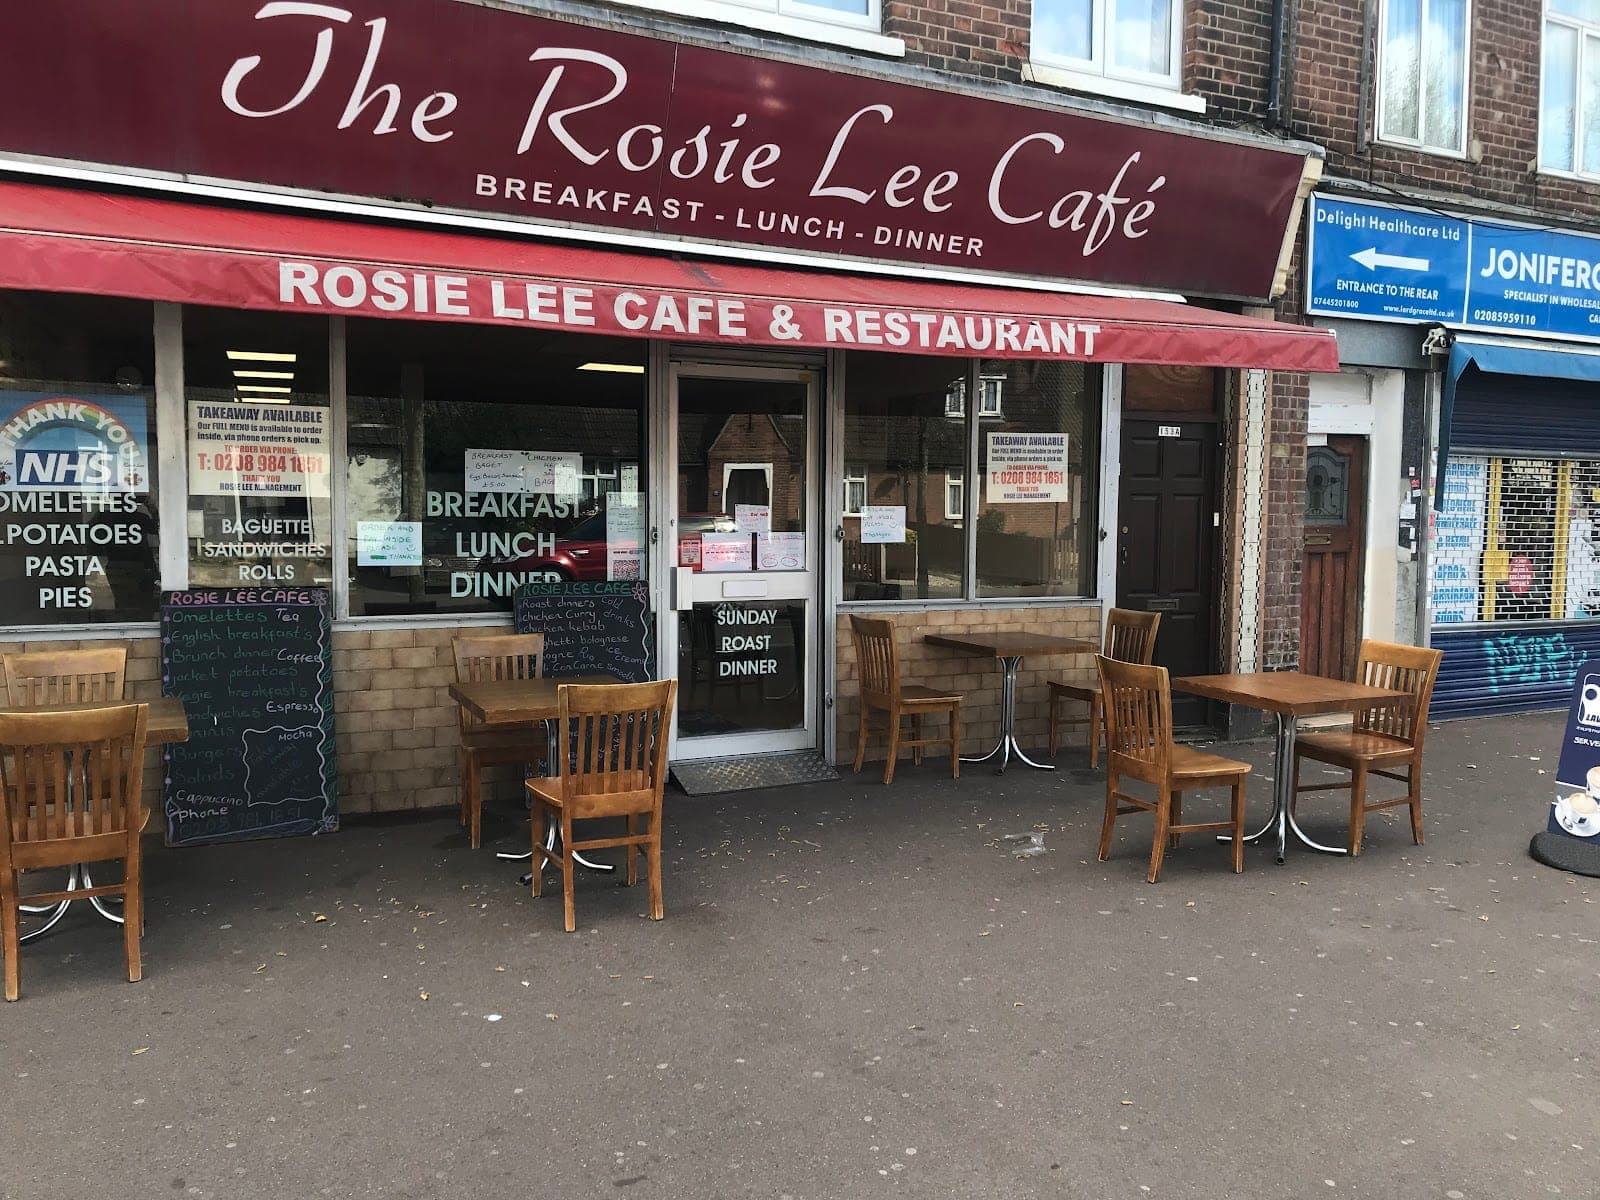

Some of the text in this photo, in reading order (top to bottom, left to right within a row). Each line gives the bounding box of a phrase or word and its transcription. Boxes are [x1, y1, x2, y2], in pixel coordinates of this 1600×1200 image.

[221, 1, 1166, 258] The Rosie Lee Café
[475, 174, 704, 222] BREAKFAST
[736, 207, 845, 240] LUNCH
[874, 226, 984, 257] DINNER
[1317, 208, 1460, 241] Delight Healthcare Ltd
[1336, 279, 1439, 300] ENTRANCE TO THE REAR
[1503, 289, 1548, 303] SPECIALIST
[1549, 295, 1558, 305] IN
[278, 262, 1101, 356] ROSIE LEE CAFE & RESTAURANT
[1474, 309, 1536, 326] 02085959110
[197, 405, 322, 424] TAKEAWAY AVAILABLE
[0, 402, 141, 460] THANK YOU
[197, 421, 322, 434] Our FULL MENU is available to order
[224, 432, 235, 441] via
[236, 432, 260, 443] phone
[261, 434, 285, 443] orders
[293, 435, 309, 444] pick
[991, 436, 1064, 446] TAKEAWAY AVAILABLE
[235, 445, 258, 453] RDER
[259, 445, 271, 454] VIA
[19, 451, 114, 484] NHS
[197, 453, 211, 471] T:
[257, 454, 287, 472] 984
[219, 482, 302, 491] ROSE LEE MNAGEMENT
[991, 471, 999, 485] T:
[1025, 471, 1042, 485] 984
[426, 491, 582, 519] BREAKFAST
[221, 518, 312, 535] BAGUETTE
[203, 541, 327, 558] SANDWICHES
[456, 531, 556, 558] LUNCH
[25, 555, 107, 577] PASTA
[239, 564, 295, 580] ROLLS
[39, 586, 93, 609] PIES
[170, 590, 311, 605] ROSIE LEE CAFE
[523, 582, 634, 597] ROSIE LEE CAFE
[522, 596, 595, 609] Roast dinners
[601, 596, 624, 610] Cold
[172, 608, 300, 623] Omelettes Tea
[602, 609, 635, 629] drinks
[717, 609, 778, 626] SUNDAY
[568, 619, 606, 632] kebab
[171, 628, 222, 648] English
[543, 635, 575, 651] ghetti
[721, 635, 772, 652] ROAST
[172, 644, 226, 664] Brunch
[277, 647, 321, 665] Coffee
[229, 662, 298, 685] potatoes
[719, 659, 778, 677] DINNER
[186, 703, 262, 721] andwiches
[266, 700, 319, 715] Espresso
[278, 730, 312, 742] Mocha
[176, 789, 244, 806] Cappuccino
[178, 806, 228, 823] phone
